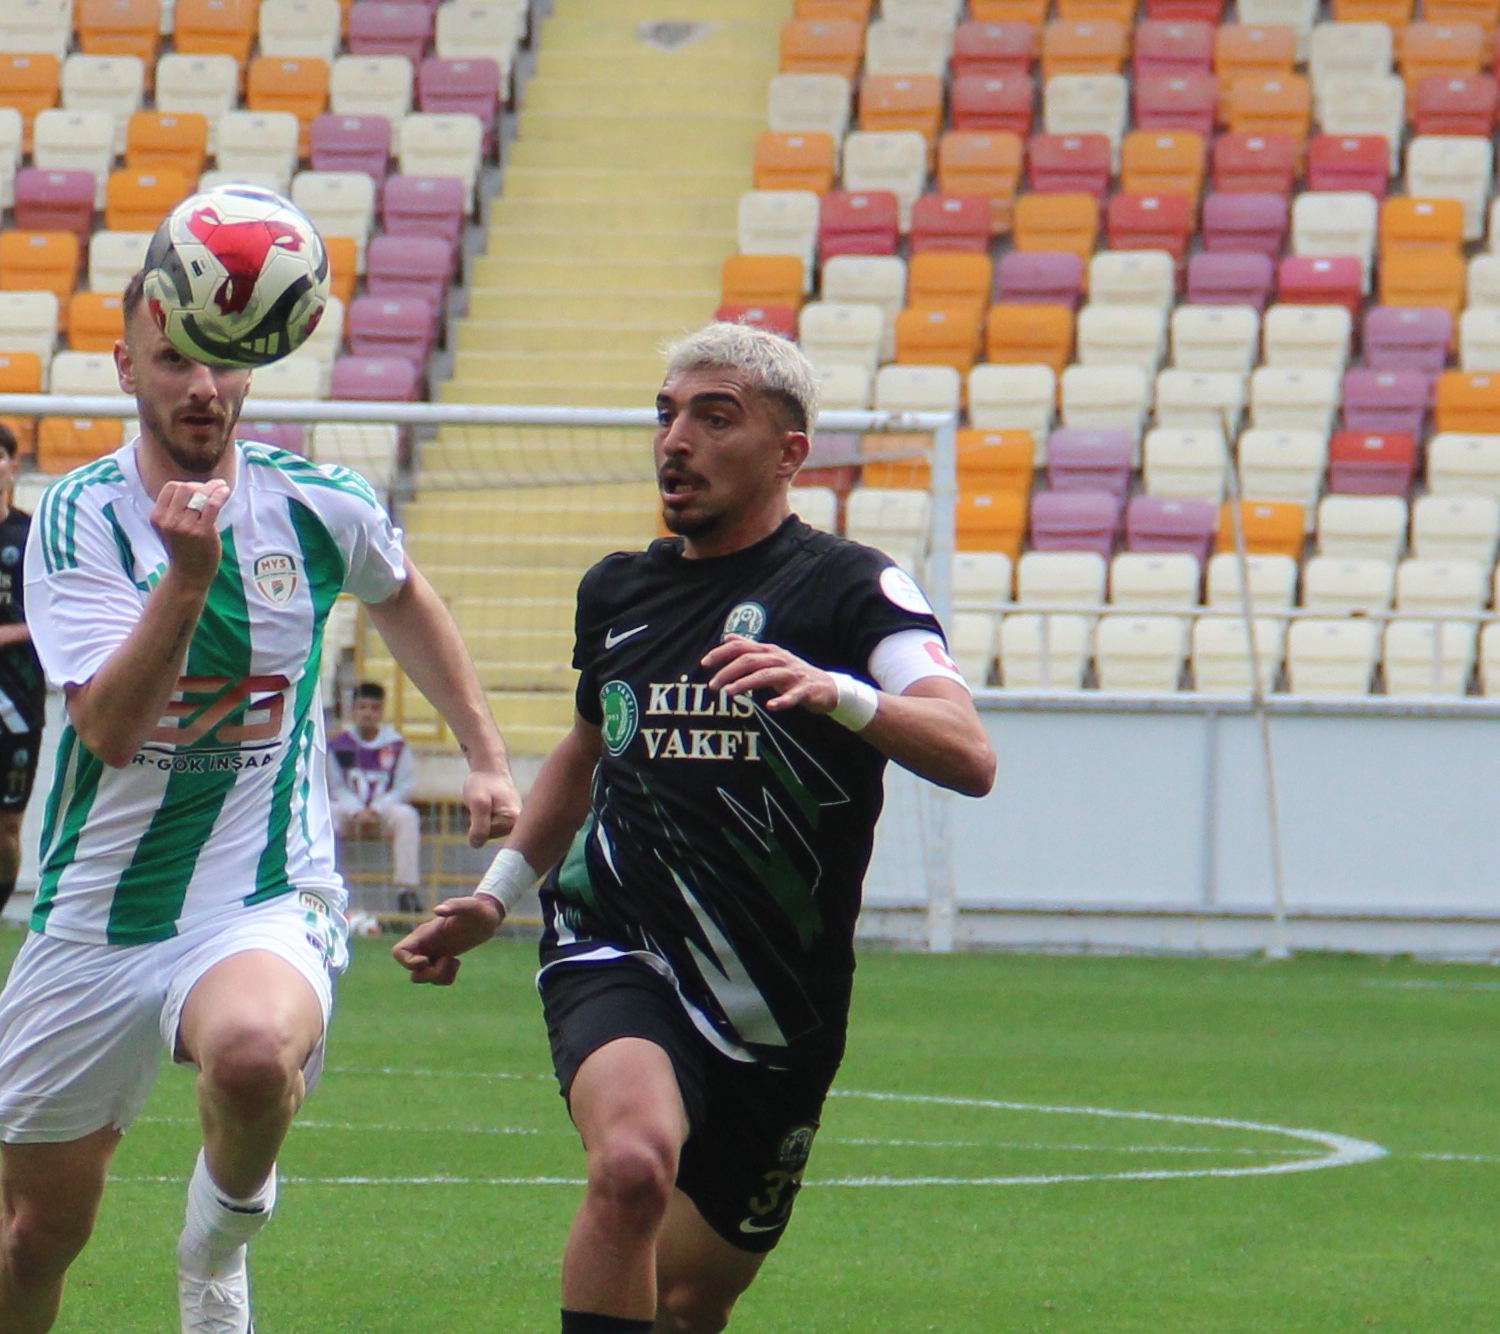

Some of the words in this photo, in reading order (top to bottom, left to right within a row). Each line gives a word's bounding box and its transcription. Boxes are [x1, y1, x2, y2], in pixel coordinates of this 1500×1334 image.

[640, 727, 761, 761] VAKFI
[132, 752, 206, 774] R-GÖK
[209, 753, 274, 773] İNŞAA
